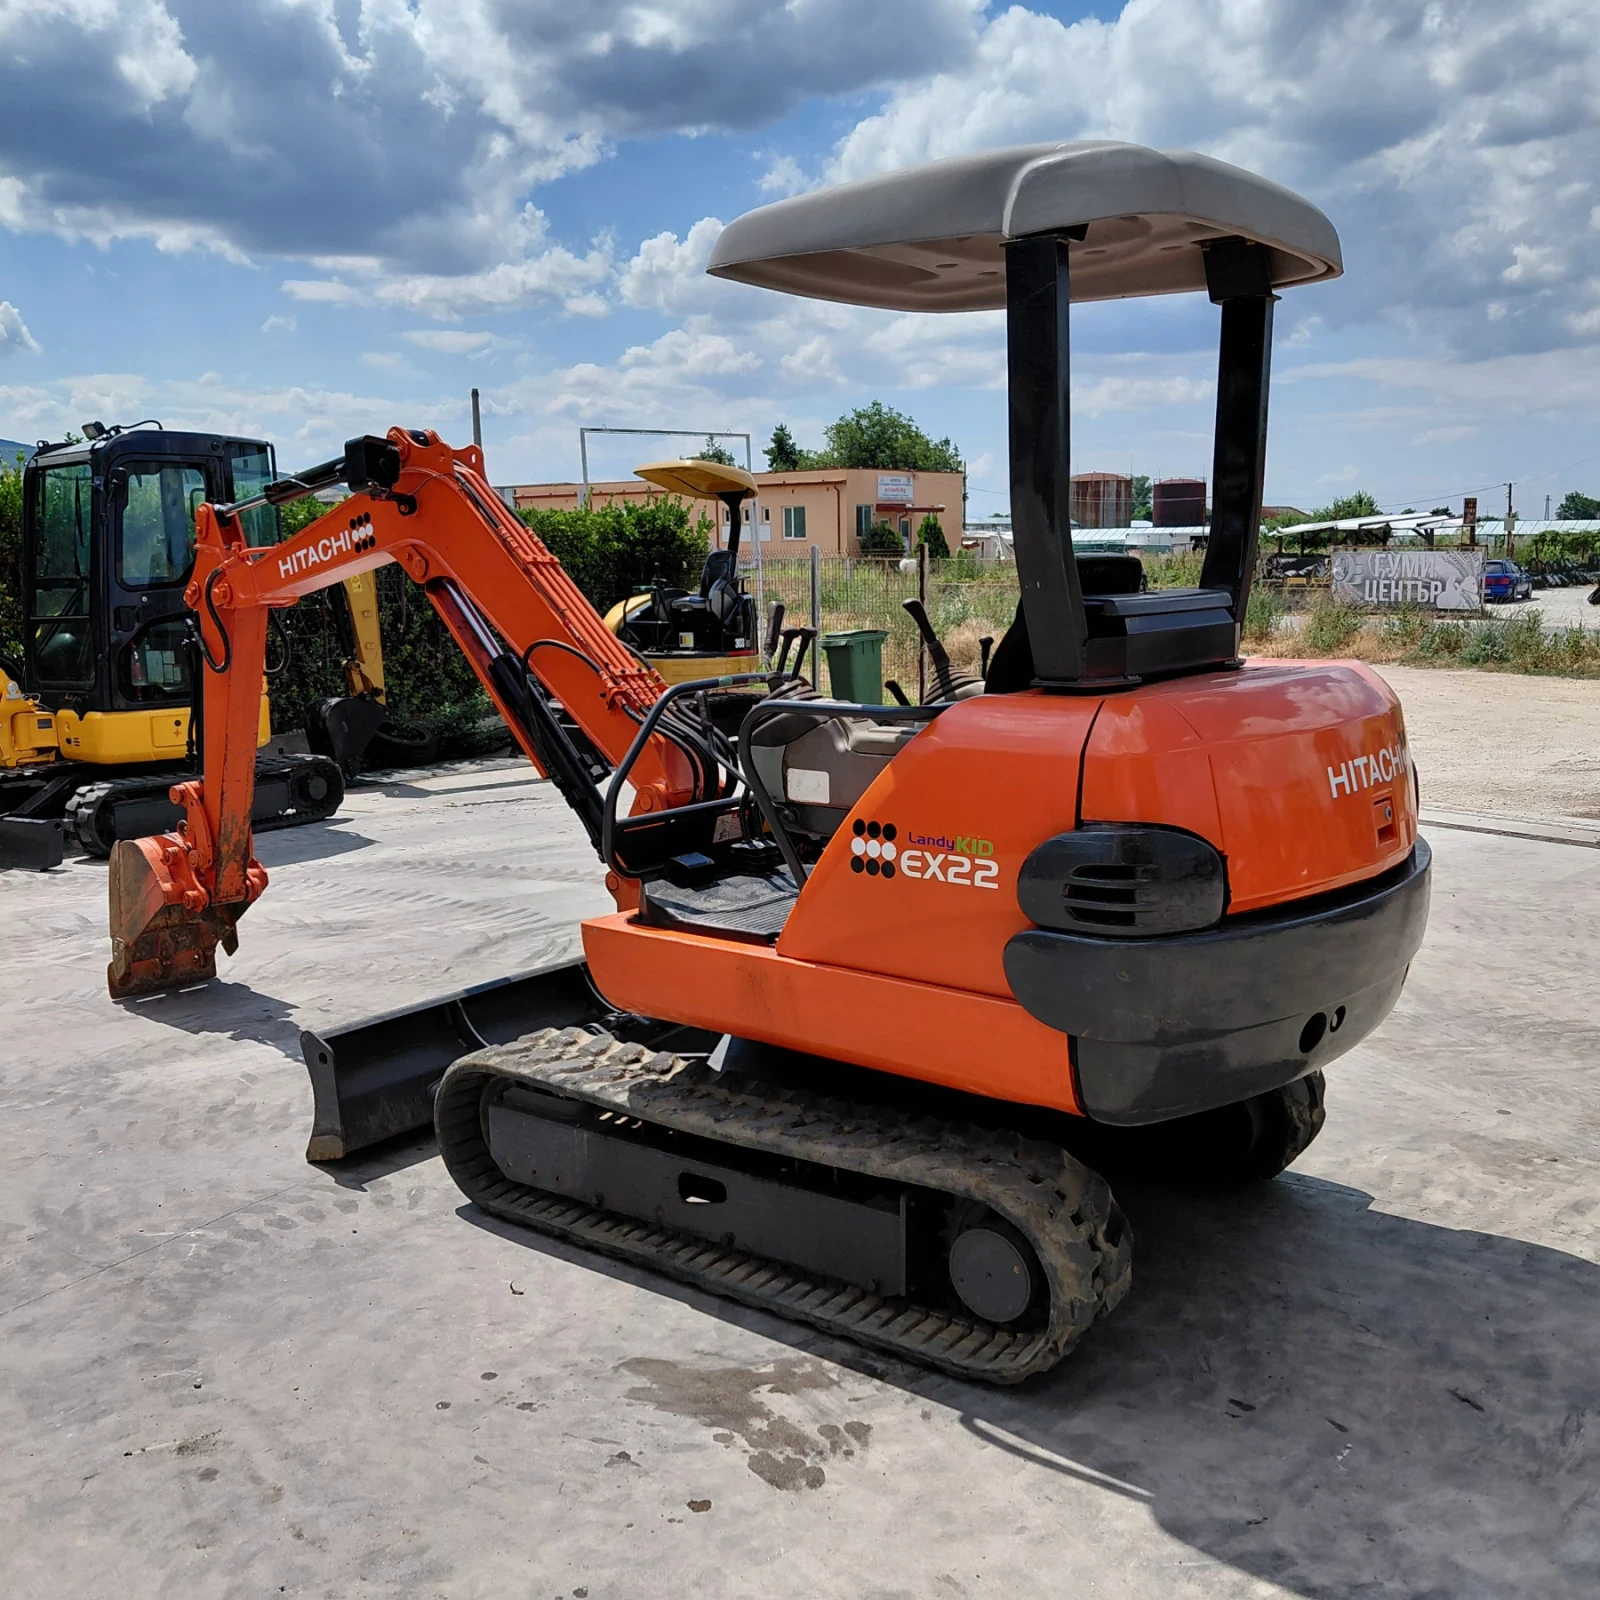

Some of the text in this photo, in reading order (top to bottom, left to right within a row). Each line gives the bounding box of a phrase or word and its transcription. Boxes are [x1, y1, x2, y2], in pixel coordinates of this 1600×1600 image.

[278, 530, 351, 579] HITACHI
[1374, 553, 1435, 579] ГУМИ
[1364, 579, 1442, 604] ЦЕНТЪР
[1327, 743, 1405, 799] HITACHI
[908, 831, 994, 857] LandyKID
[900, 849, 999, 889] EX22
